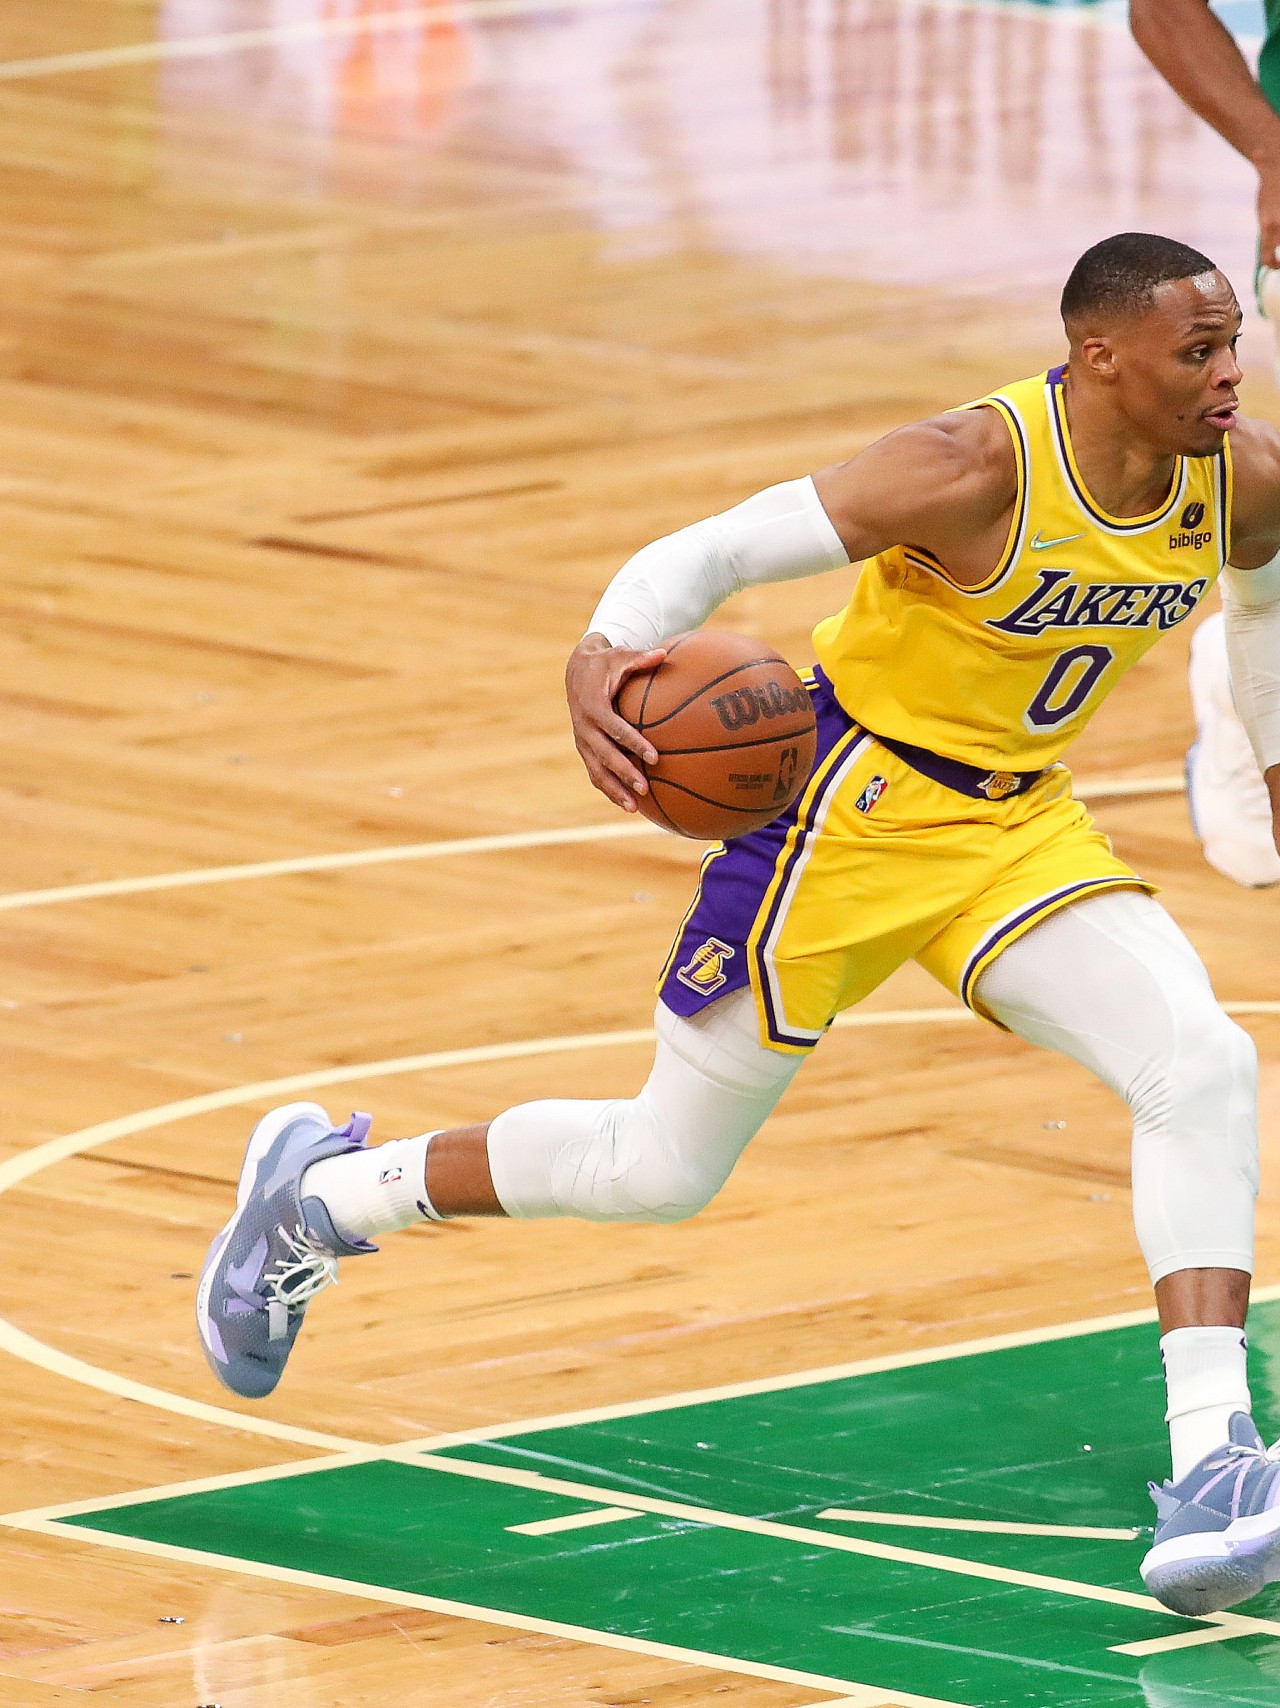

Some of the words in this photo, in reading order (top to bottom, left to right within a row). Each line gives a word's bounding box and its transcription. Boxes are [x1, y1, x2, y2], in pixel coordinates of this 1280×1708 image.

[1169, 531, 1212, 550] bibigo
[985, 567, 1207, 638] LAKERS
[1021, 644, 1116, 735] 0
